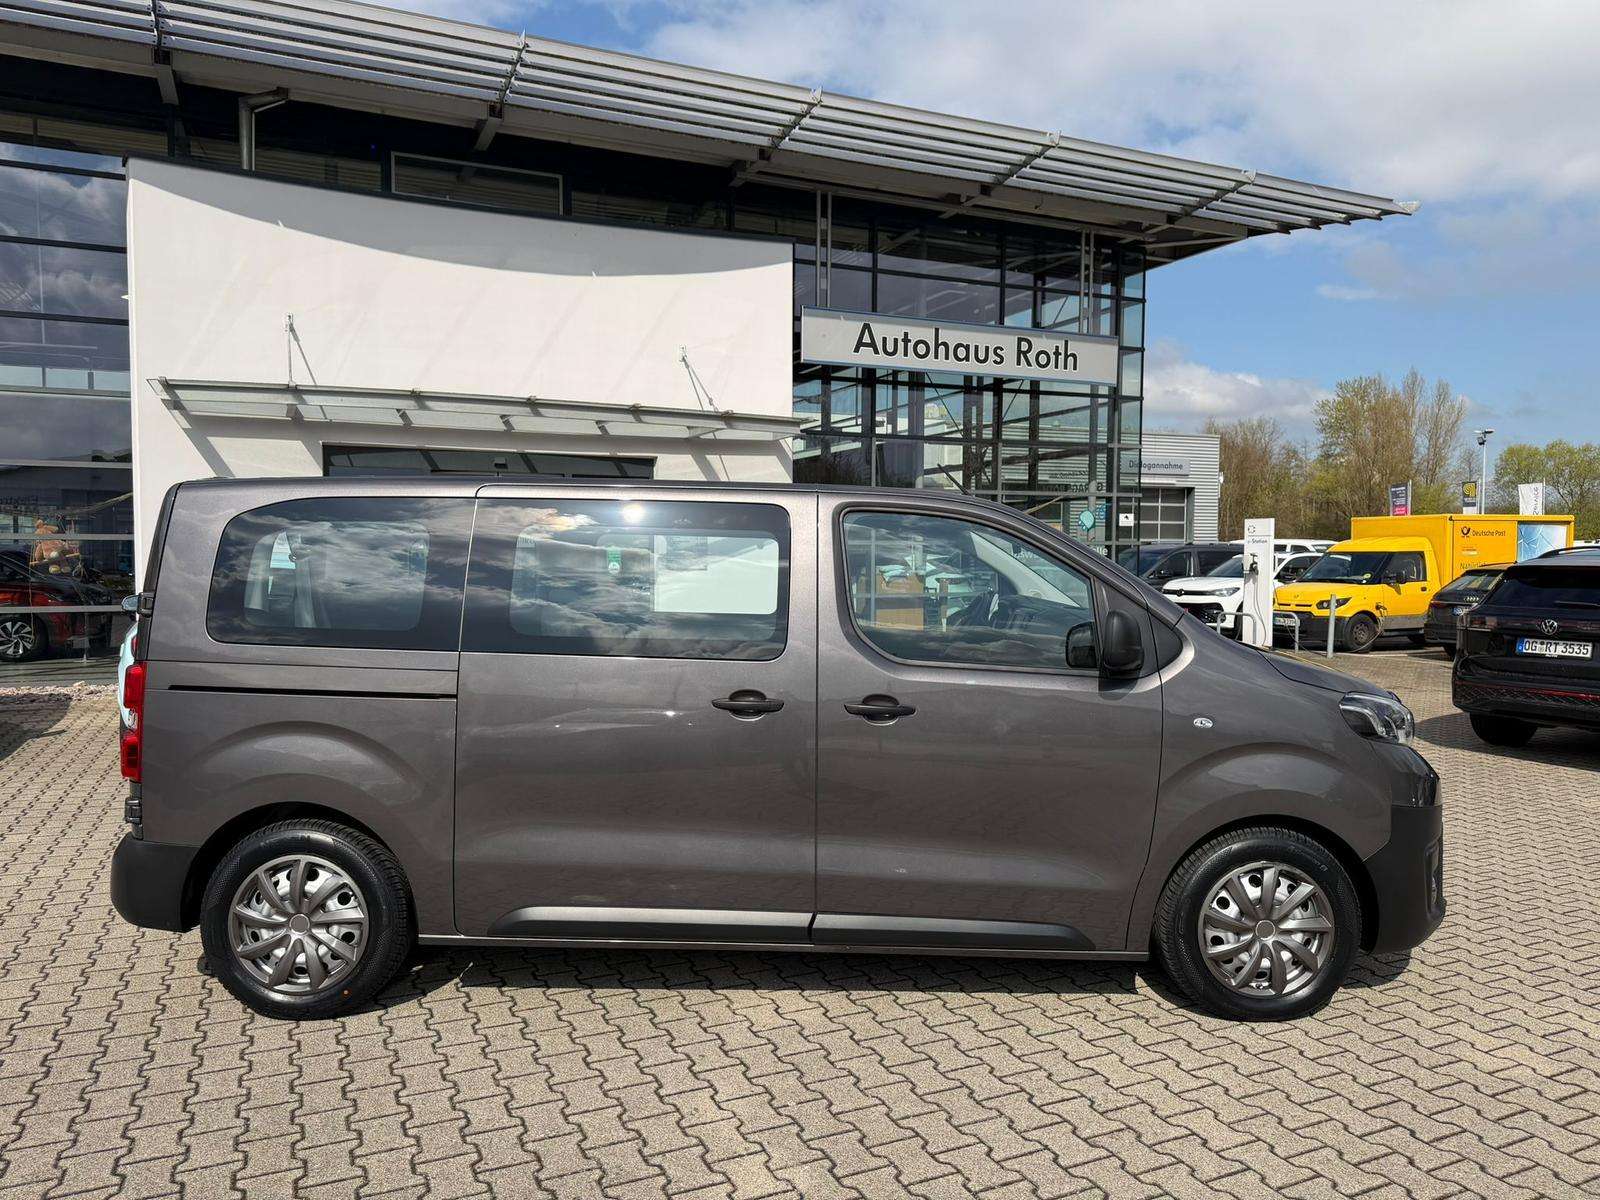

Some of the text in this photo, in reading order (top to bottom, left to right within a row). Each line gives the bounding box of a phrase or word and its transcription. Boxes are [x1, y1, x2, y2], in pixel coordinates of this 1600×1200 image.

[853, 322, 1078, 371] Autohaus Roth
[1524, 640, 1537, 652] OG
[1545, 642, 1559, 653] RT
[1561, 643, 1589, 656] 3535
